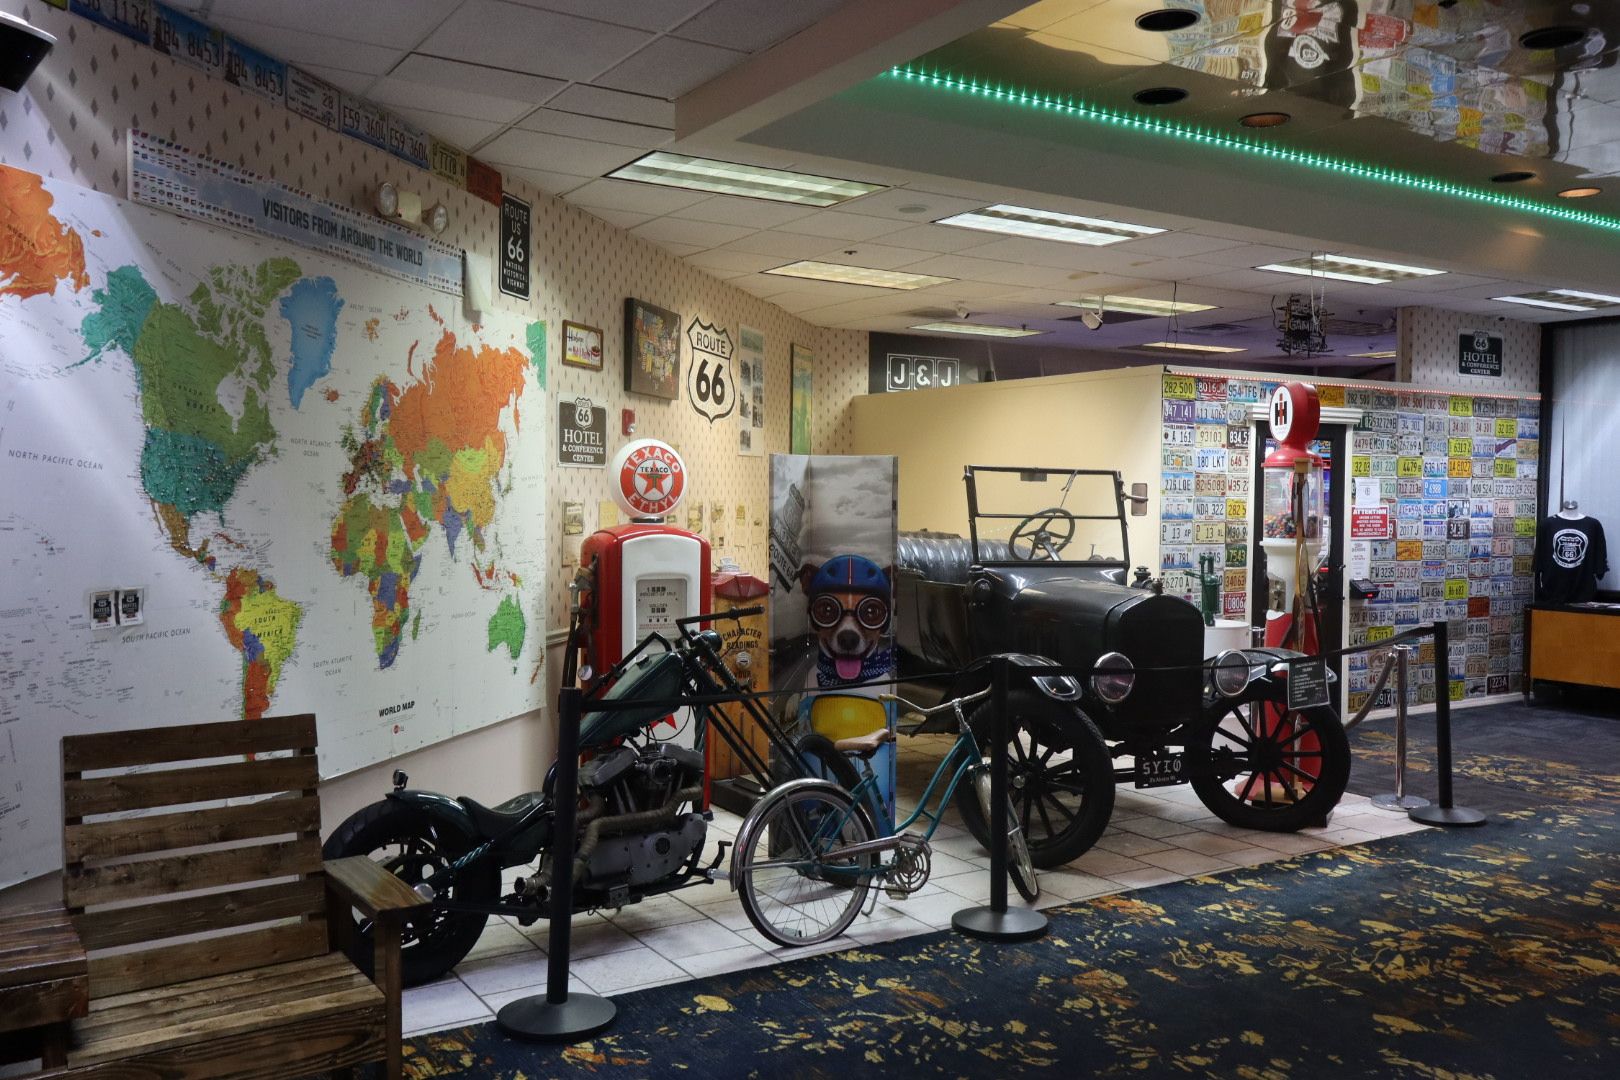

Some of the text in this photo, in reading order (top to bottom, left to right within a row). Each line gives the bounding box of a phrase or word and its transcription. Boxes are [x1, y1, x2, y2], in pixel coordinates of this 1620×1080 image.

[504, 203, 528, 225] ROUTE
[263, 199, 423, 266] VISITORS FROM AROUND THE WORLD
[511, 221, 521, 236] US
[507, 235, 524, 262] 66
[696, 332, 726, 355] ROUTE
[1475, 338, 1487, 349] 66
[1463, 351, 1499, 364] HOTEL
[695, 358, 726, 406] 66
[893, 363, 952, 387] J & J
[1164, 381, 1193, 395] 282 500
[578, 408, 590, 423] 66
[563, 429, 602, 445] HOTEL
[562, 444, 604, 454] & CONFERENCE
[8, 448, 104, 471] NORTH PACIFIC OCEAN
[572, 454, 595, 463] CENTER
[623, 446, 681, 473] TEXACO
[1212, 456, 1225, 468] LKT
[640, 466, 669, 474] TEXACO
[627, 491, 679, 513] ETHYL
[1196, 503, 1224, 516] NDA 322
[1227, 503, 1240, 516] 282
[1172, 527, 1181, 540] 13
[1206, 527, 1214, 539] 13
[1399, 525, 1413, 536] 2017
[1381, 567, 1395, 578] 3235
[121, 627, 191, 644] SOUTH PACIFIC OCEAN
[378, 701, 415, 718] WORLD MAP
